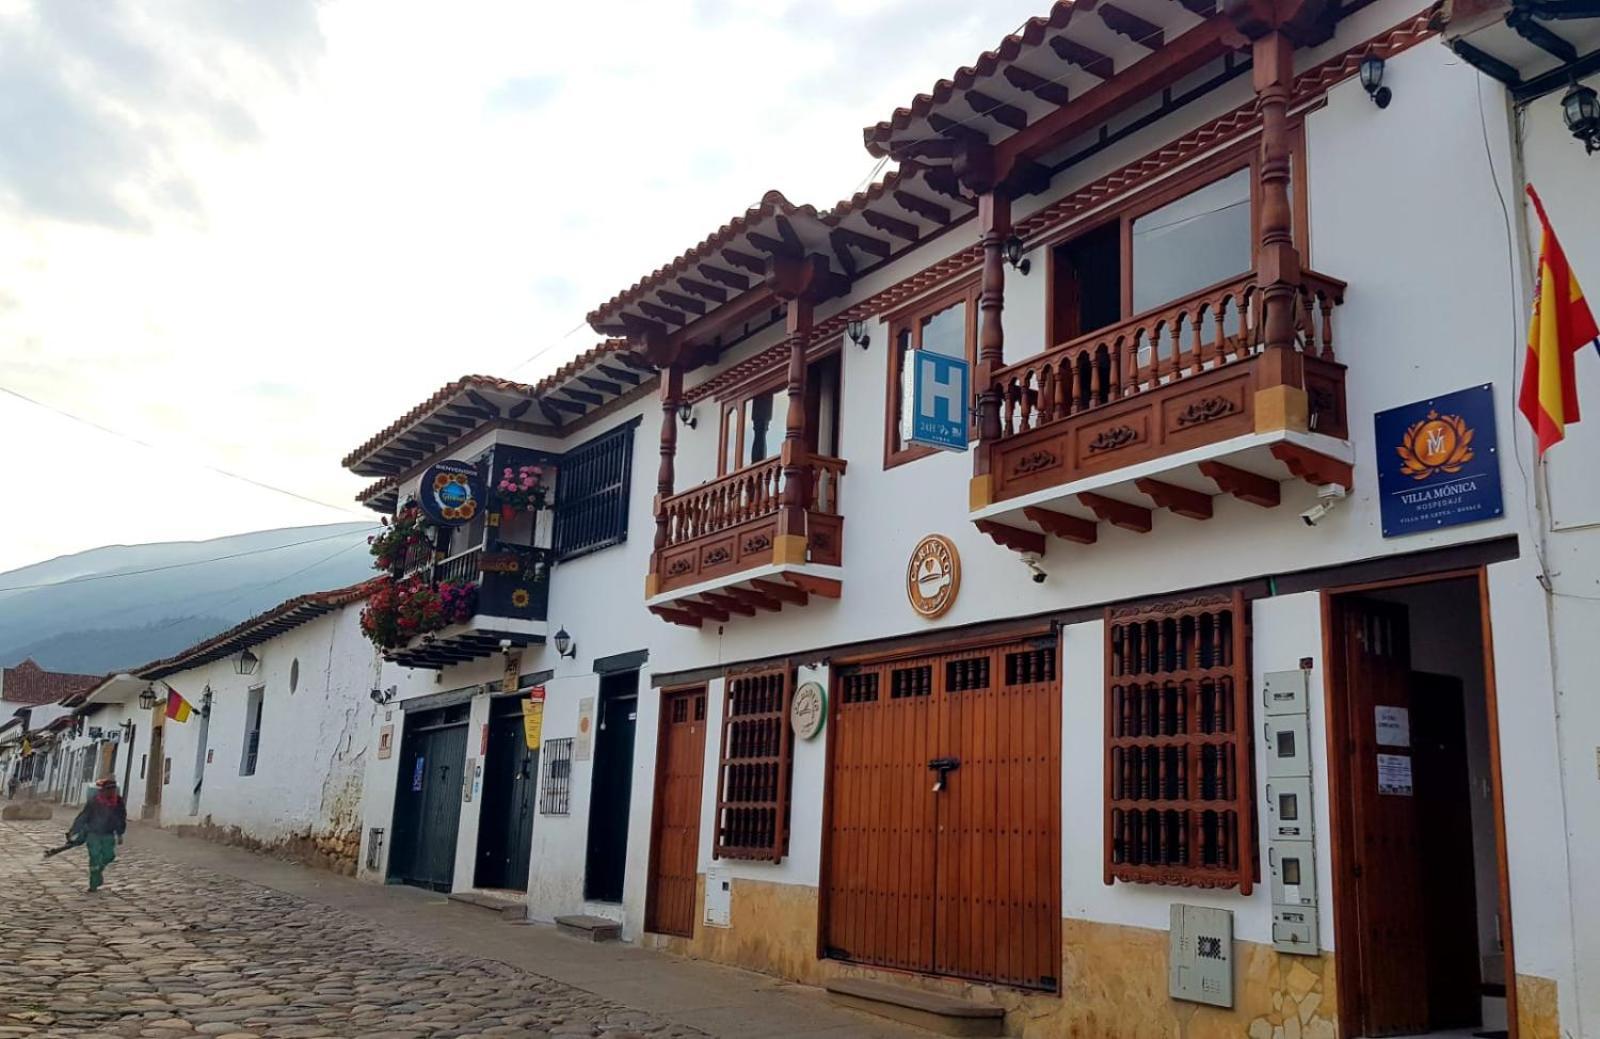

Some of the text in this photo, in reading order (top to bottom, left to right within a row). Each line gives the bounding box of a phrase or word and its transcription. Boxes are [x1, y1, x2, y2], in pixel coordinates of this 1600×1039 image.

[921, 359, 962, 424] H
[1401, 481, 1477, 504] VILLA MÓNICA
[1416, 497, 1463, 511] HOSPEDAJE
